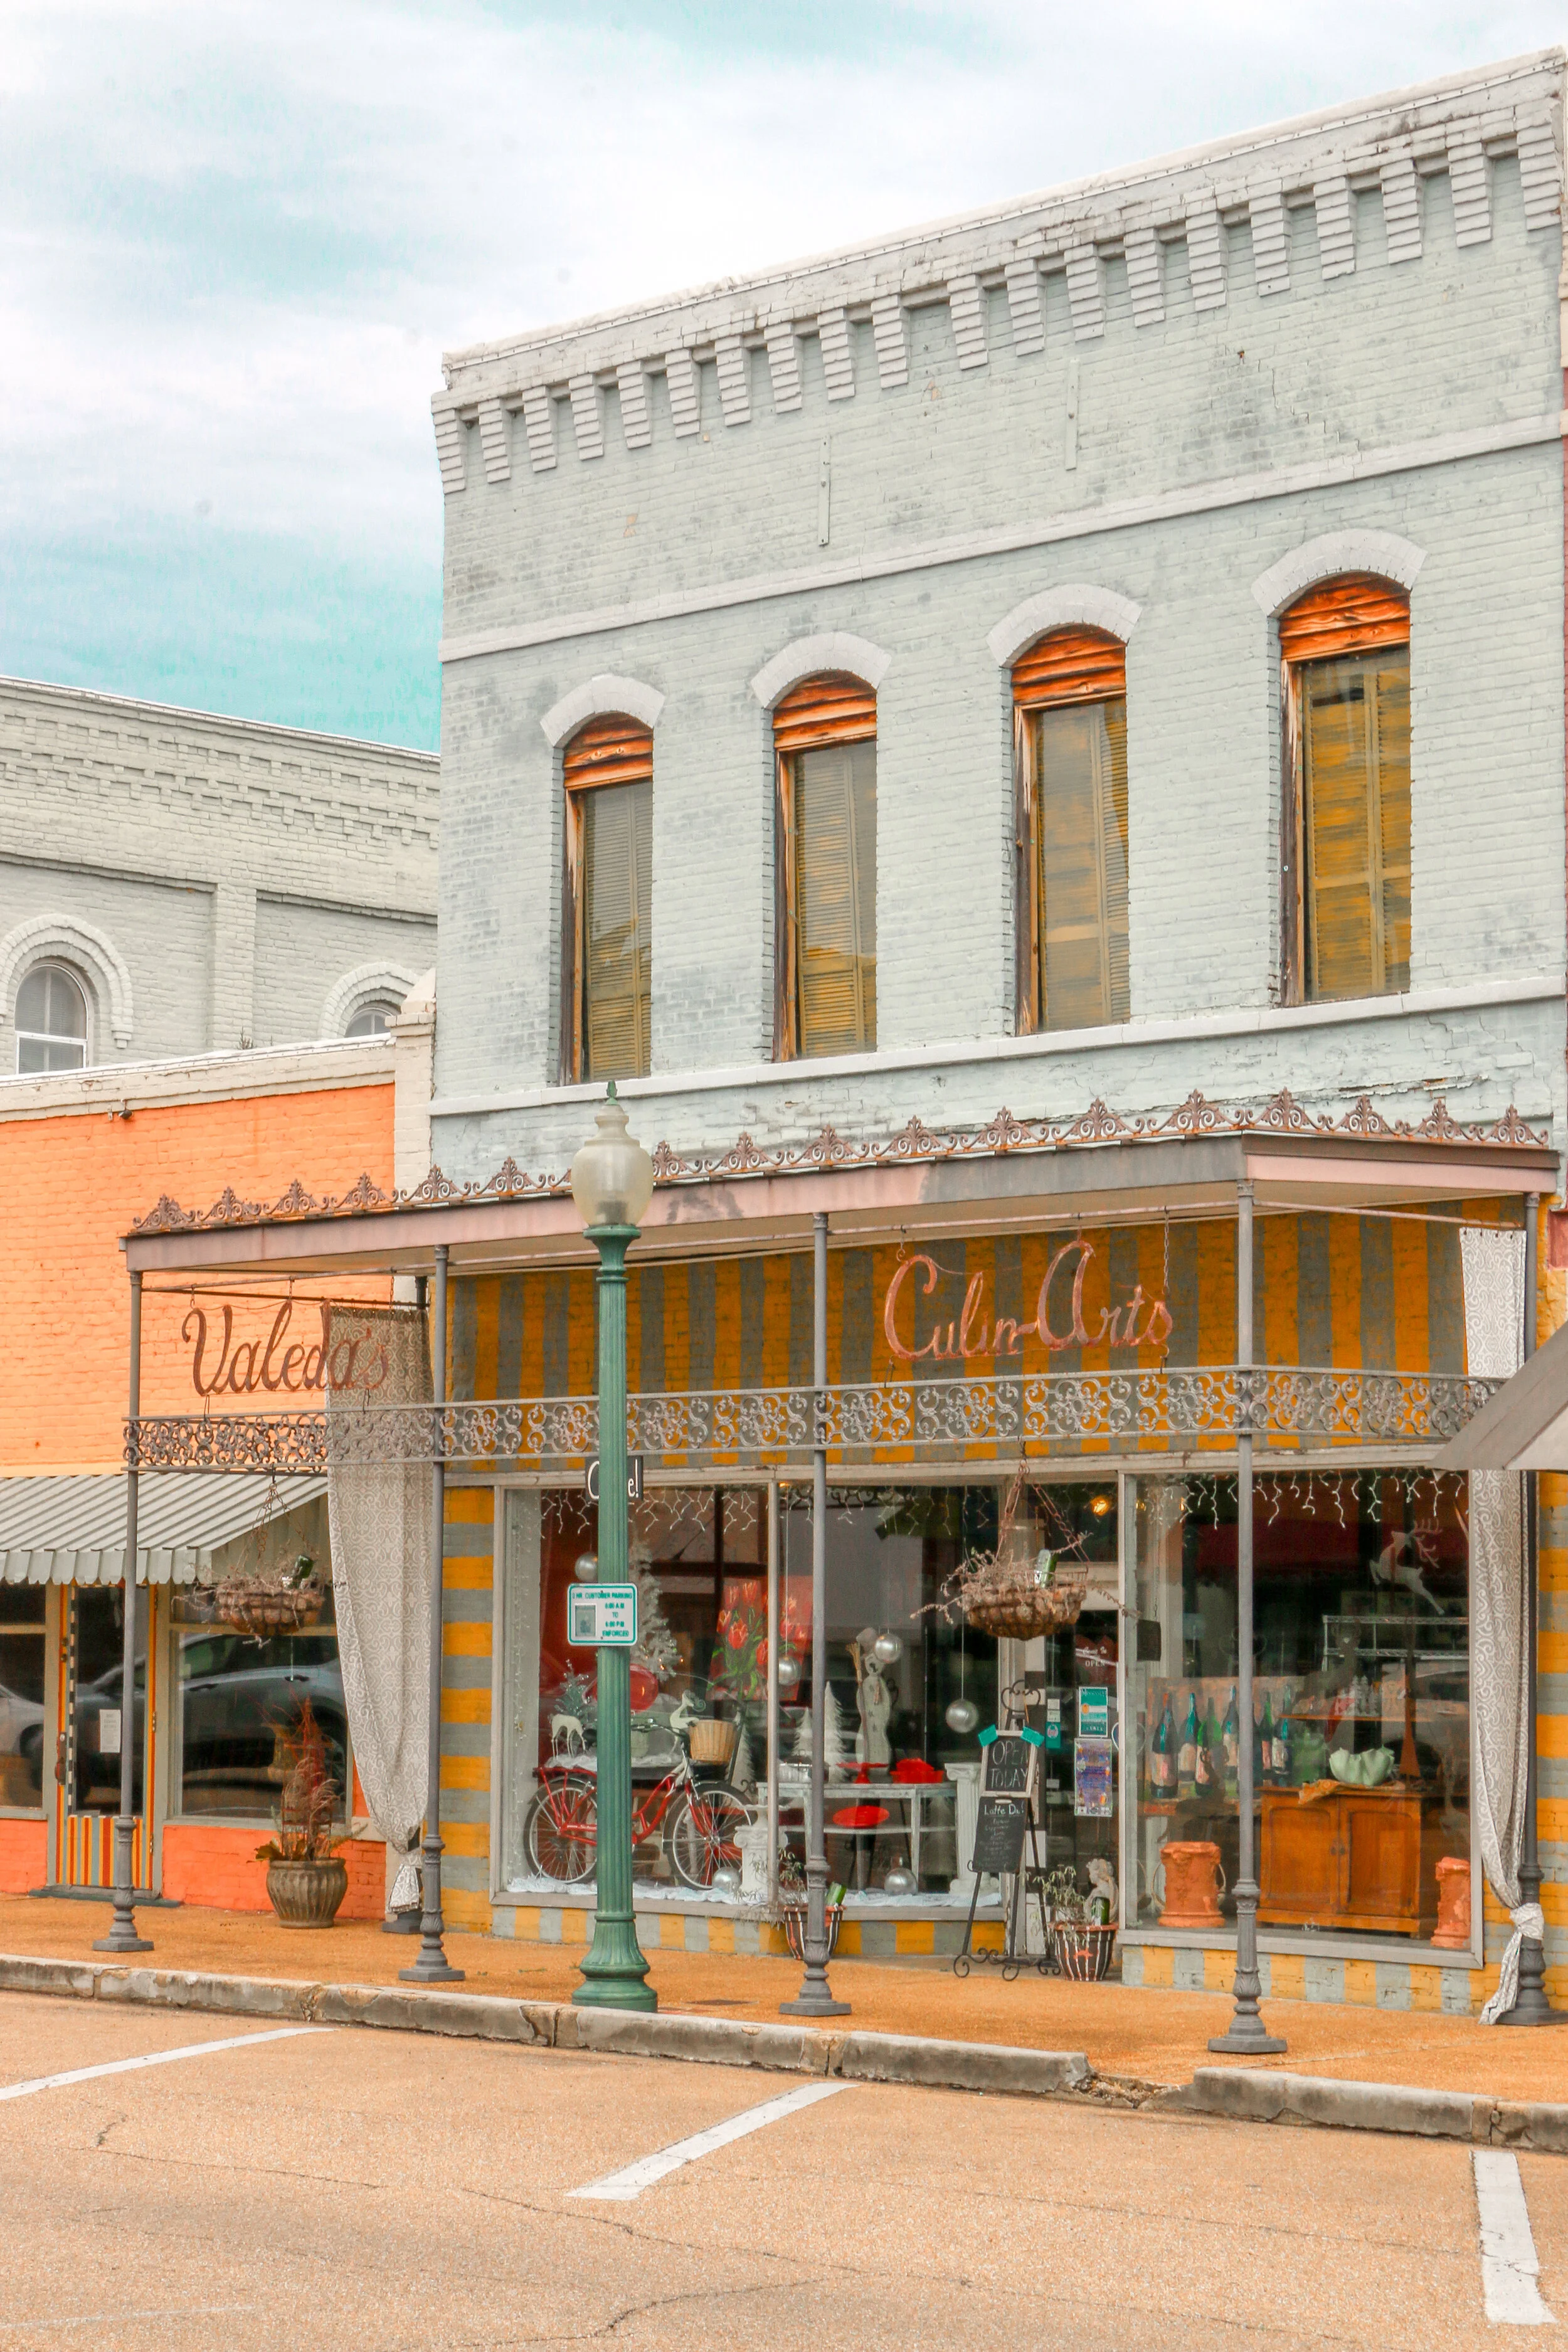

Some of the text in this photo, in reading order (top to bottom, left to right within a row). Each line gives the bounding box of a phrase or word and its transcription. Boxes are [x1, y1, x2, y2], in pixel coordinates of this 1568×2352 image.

[181, 1298, 388, 1397] Valeda's
[992, 1740, 1029, 1766] OPEN
[990, 1767, 1029, 1789] TODAY
